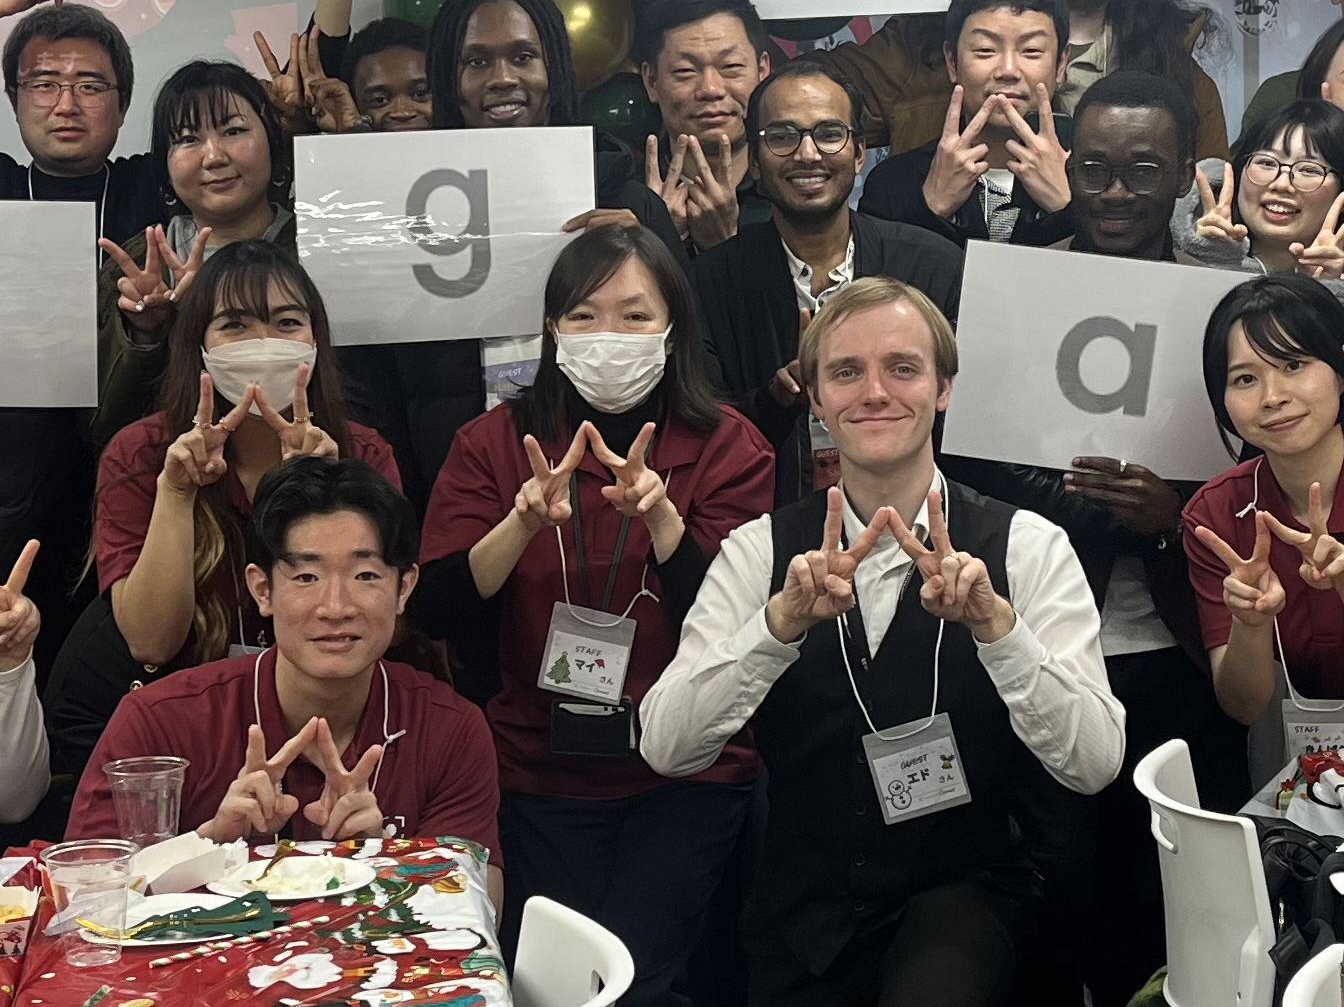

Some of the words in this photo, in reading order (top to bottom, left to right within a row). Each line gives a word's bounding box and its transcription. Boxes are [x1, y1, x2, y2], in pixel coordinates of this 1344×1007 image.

[405, 168, 491, 298] g
[497, 368, 522, 378] GUEST
[1056, 315, 1157, 417] a
[816, 449, 838, 458] GUEST
[575, 645, 603, 656] STAFF
[575, 658, 595, 672] マイ
[901, 754, 928, 770] GUEST
[907, 768, 930, 784] エド
